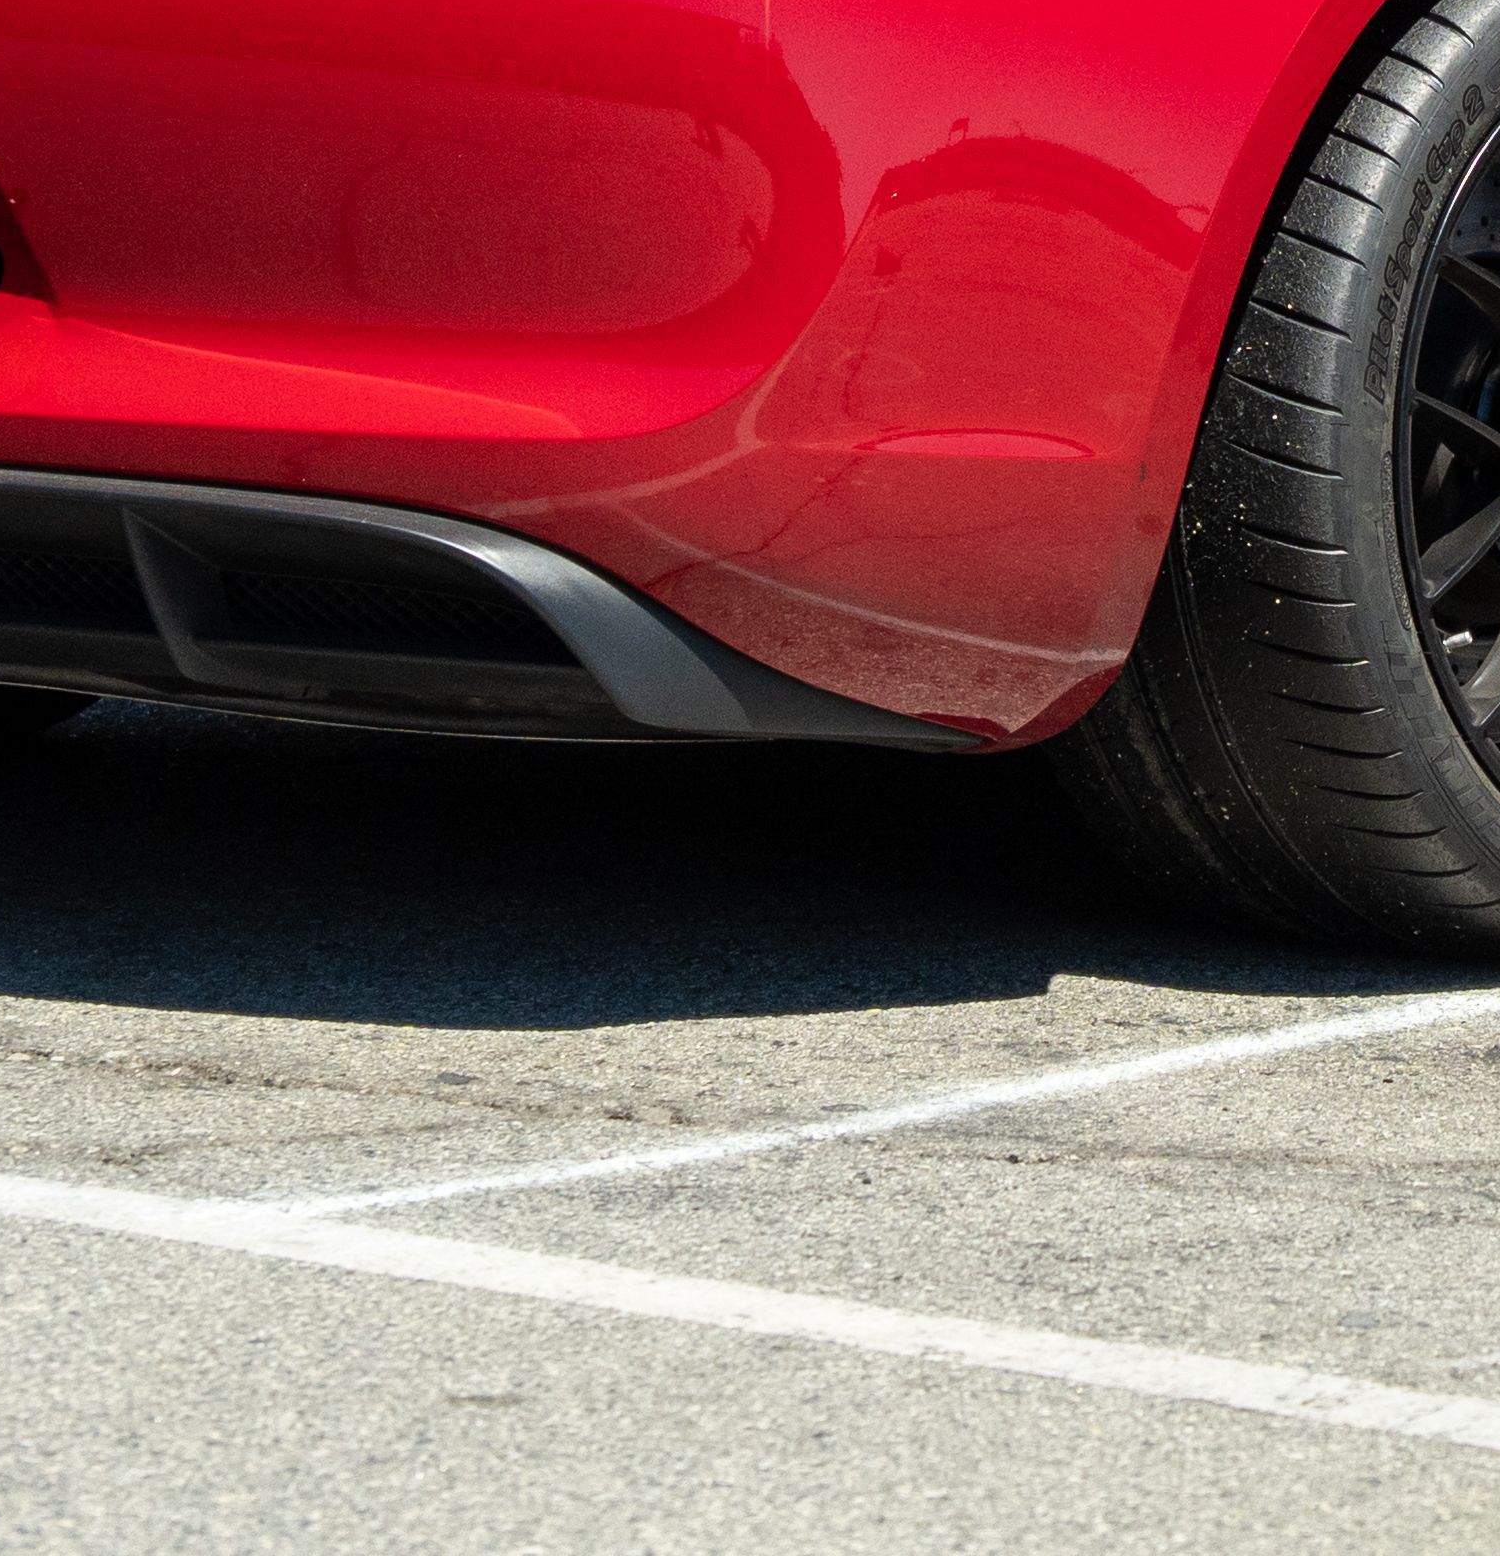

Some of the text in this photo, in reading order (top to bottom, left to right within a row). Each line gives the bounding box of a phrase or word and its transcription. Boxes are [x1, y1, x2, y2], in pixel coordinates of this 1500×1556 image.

[1363, 84, 1485, 404] Pilot Sport Cup 2
